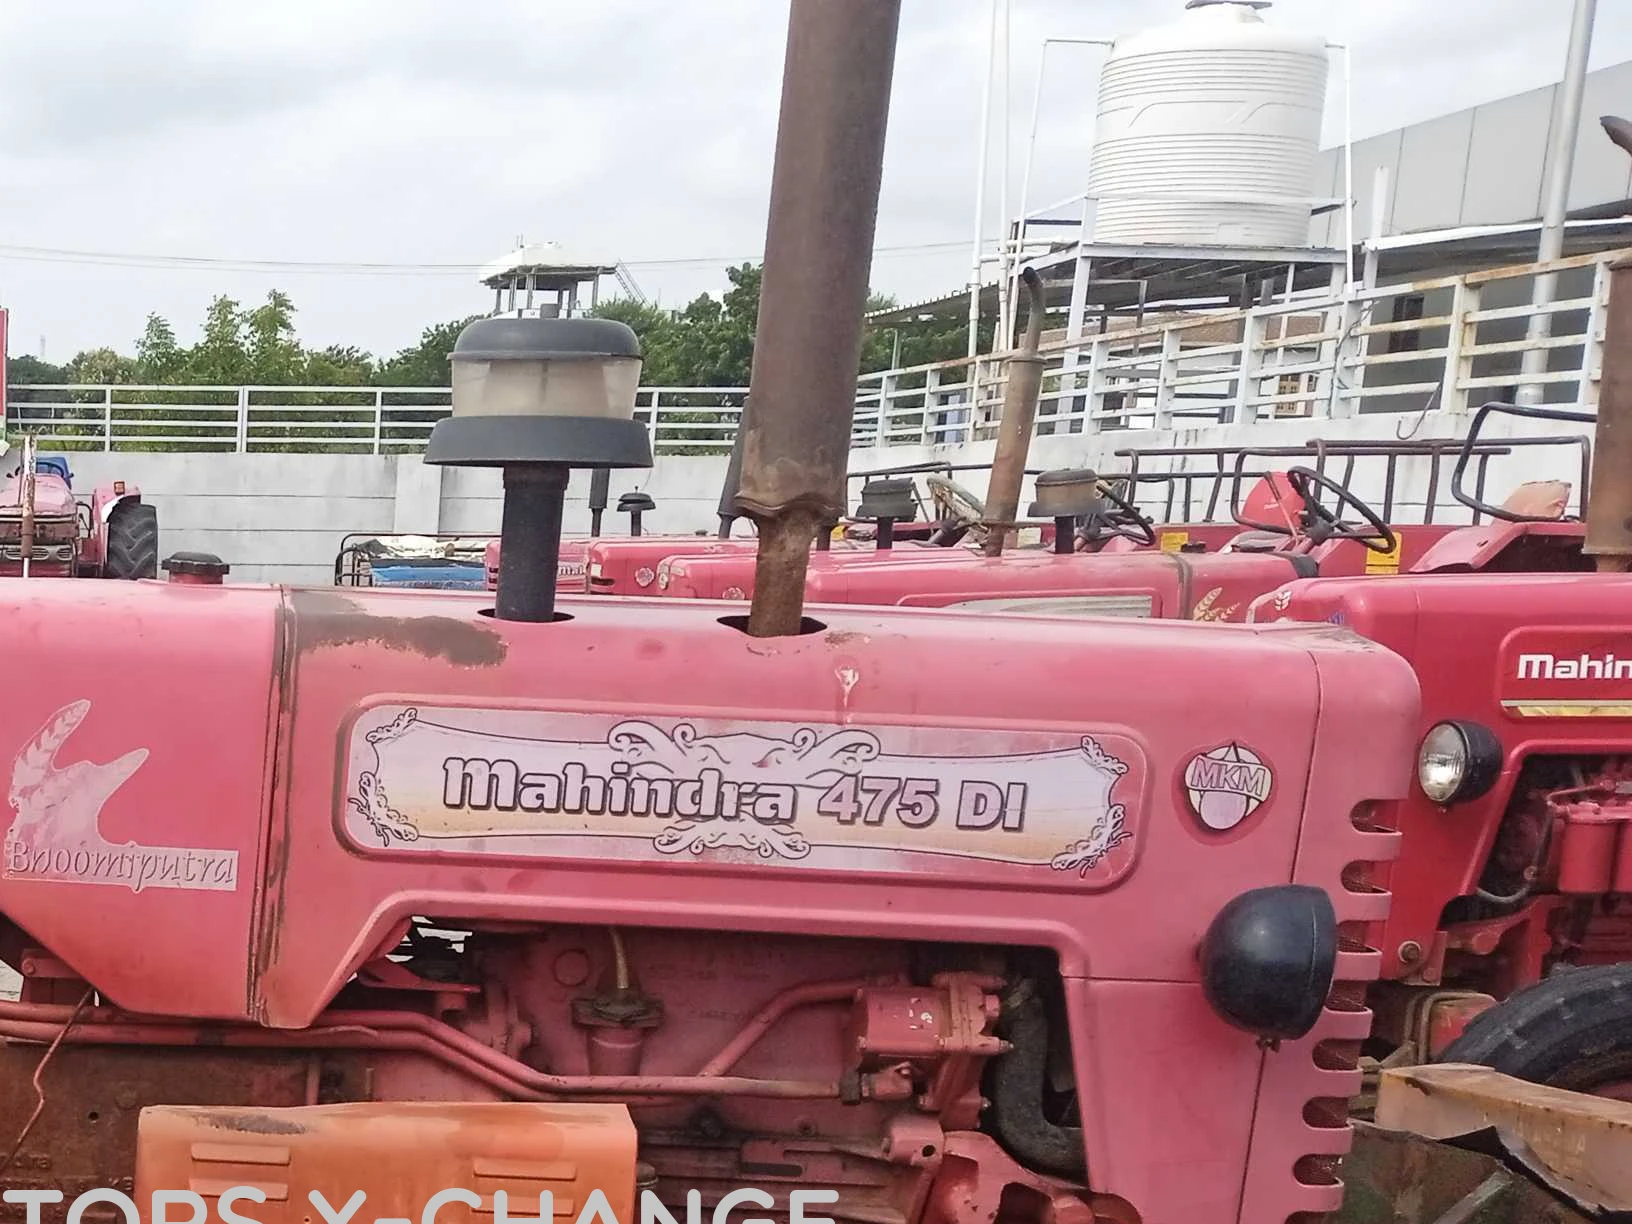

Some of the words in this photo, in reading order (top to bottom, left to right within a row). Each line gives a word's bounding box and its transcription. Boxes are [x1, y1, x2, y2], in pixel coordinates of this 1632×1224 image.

[1517, 653, 1632, 679] Mahin
[443, 756, 798, 822] Mahindra
[817, 774, 940, 829] 475
[956, 780, 1028, 832] DI
[1191, 757, 1266, 797] MKM
